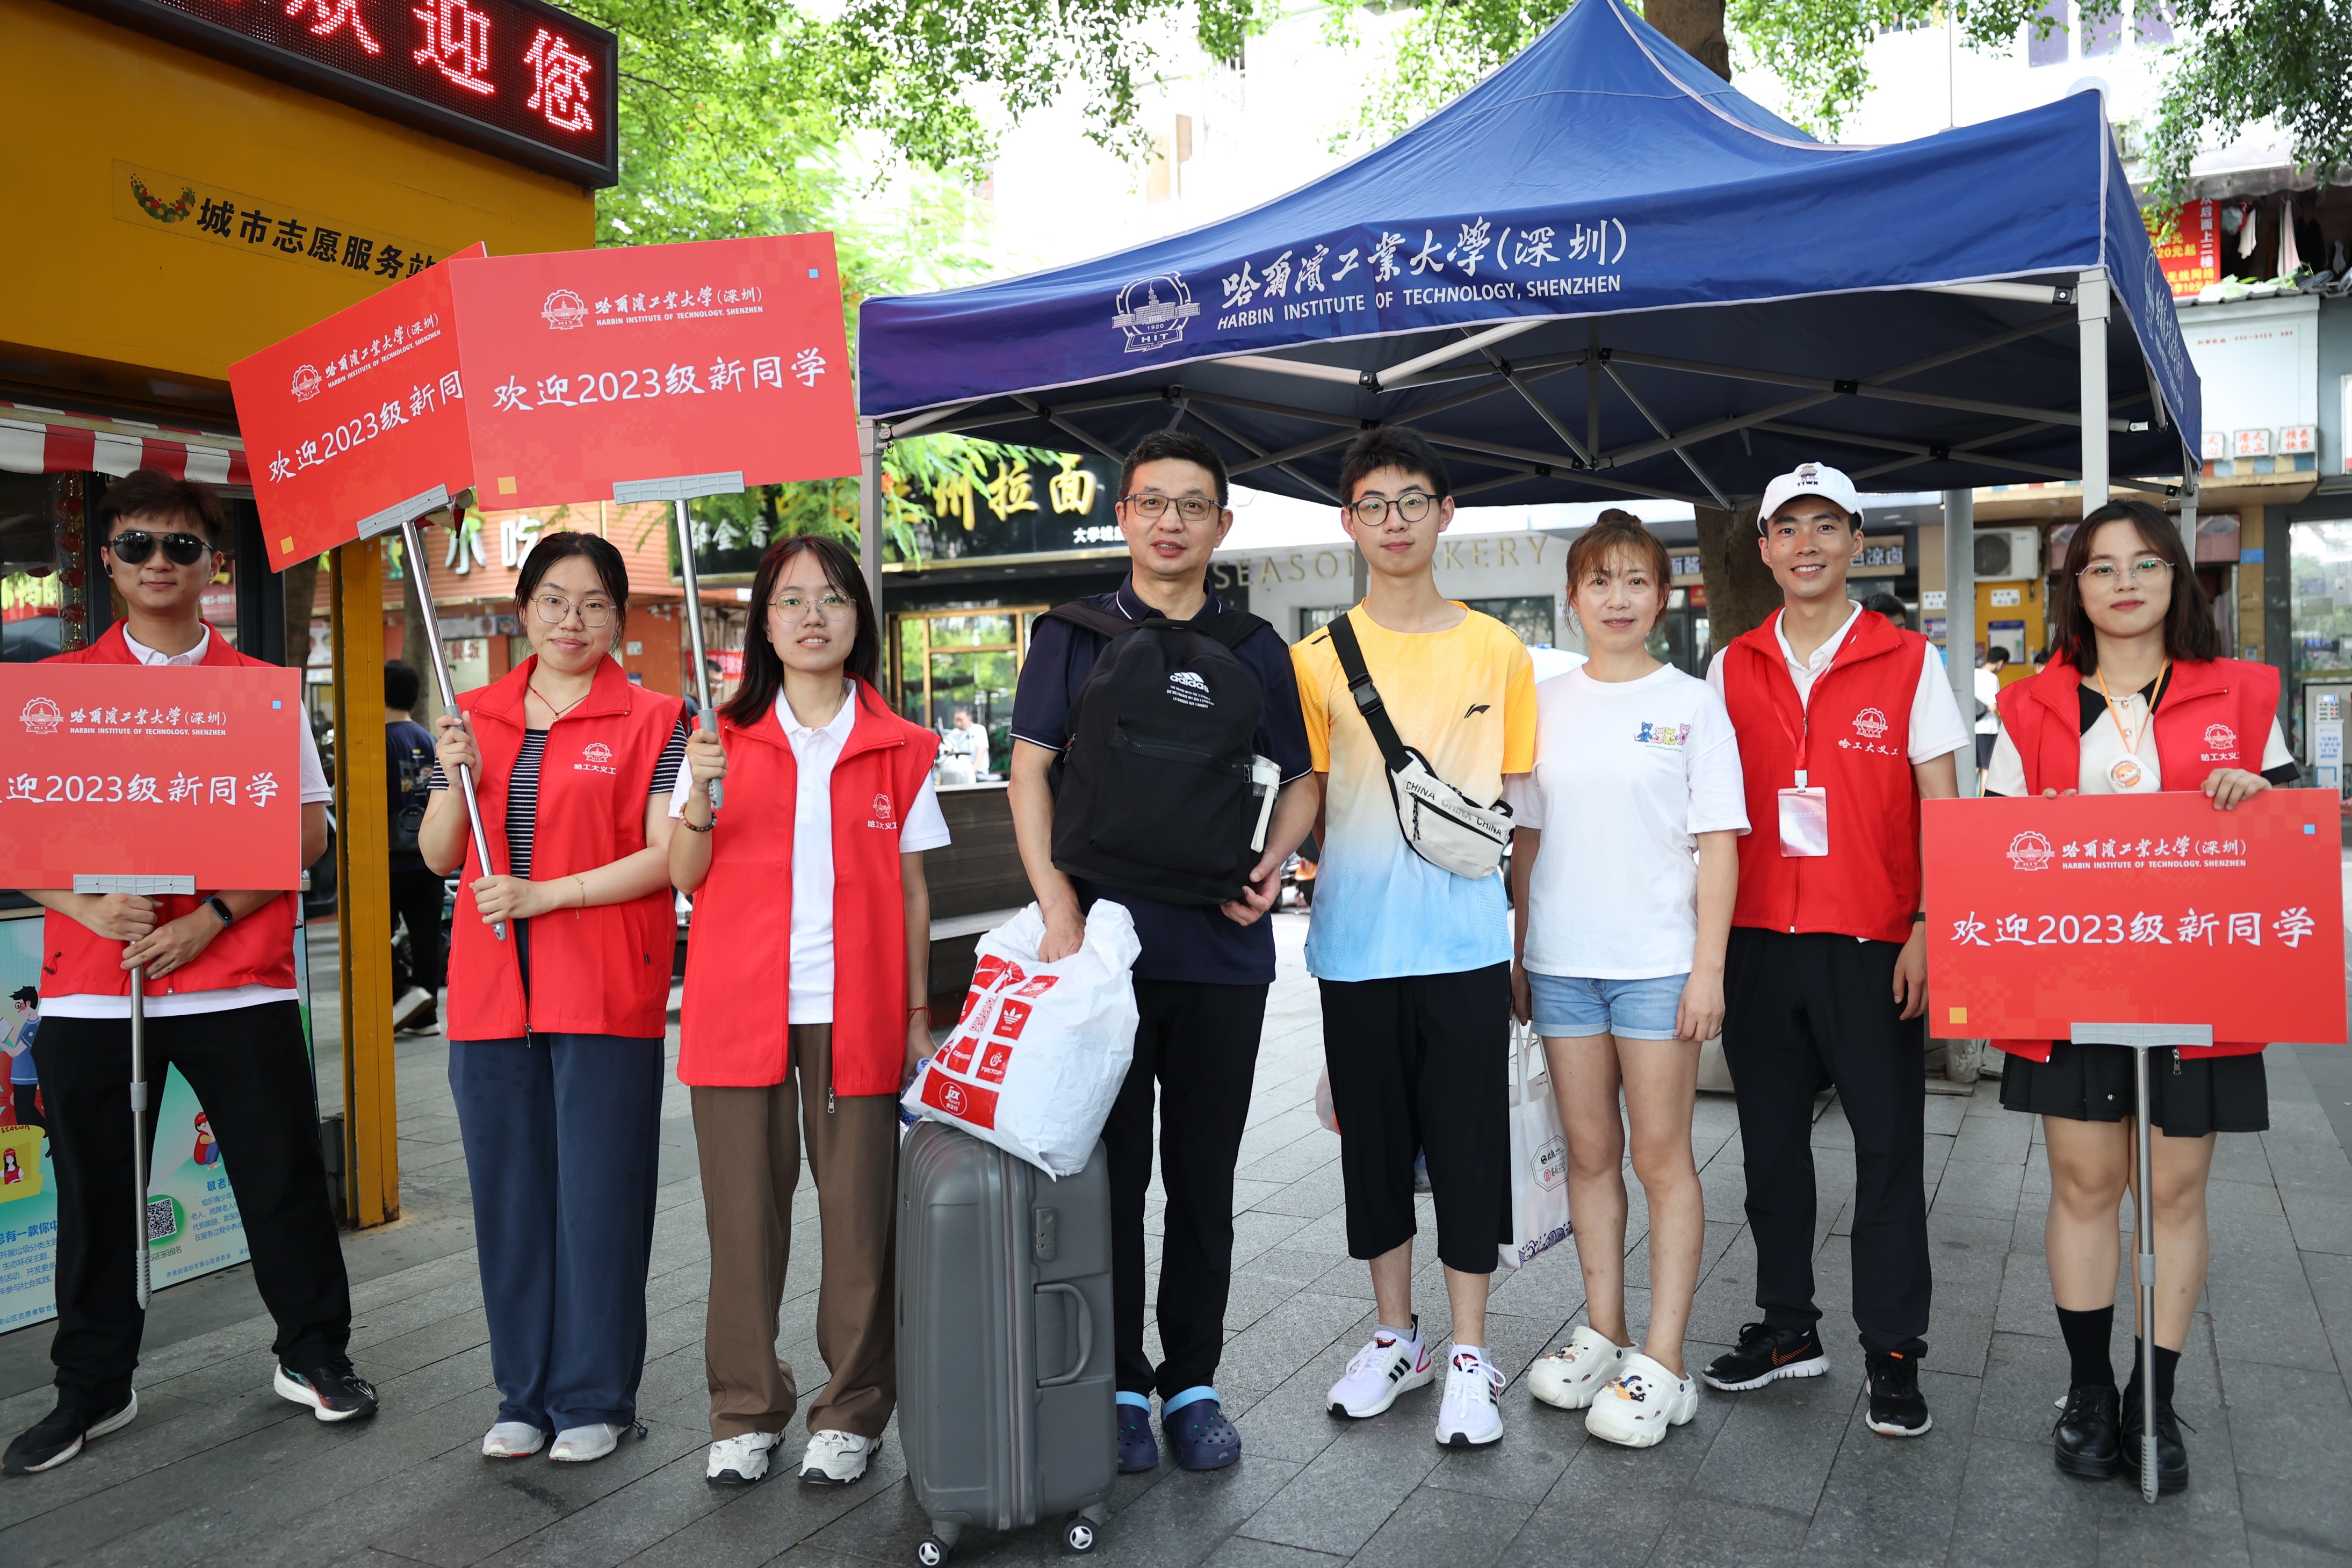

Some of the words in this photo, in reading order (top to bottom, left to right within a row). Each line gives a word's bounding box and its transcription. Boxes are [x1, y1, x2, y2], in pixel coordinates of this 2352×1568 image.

[1217, 308, 1274, 330] HARBIN
[1283, 294, 1366, 321] INSTITUTE
[1375, 291, 1394, 309] OF
[1403, 282, 1521, 306] TECHNOLOGY,
[1526, 274, 1621, 297] SHENZHEN
[596, 317, 624, 326] HARBIN
[626, 314, 661, 324] INSTITUTE
[727, 306, 763, 315] SHENZHEN
[1141, 333, 1169, 343] HIT
[328, 375, 346, 388] HARBIN
[347, 363, 372, 379] INSTITUTE
[372, 358, 379, 366] OF
[415, 329, 441, 346] SHENZHEN
[492, 347, 826, 412] 欢迎2023级新同学
[1433, 536, 1548, 573] KERY
[1170, 674, 1209, 693] adidas
[1838, 738, 1898, 755] 哈工大义工
[574, 763, 616, 775] 哈工大义工
[0, 771, 279, 807] 迎2023级新同学
[1406, 781, 1435, 800] CHINA
[1477, 817, 1502, 837] CHINA
[868, 820, 897, 829] 哈工大义工
[2062, 862, 2090, 870] HARBIN
[2094, 861, 2132, 869] INSTITUTE
[2204, 859, 2246, 868] SHENZHEN
[1950, 907, 2315, 948] 欢迎2023级新同学
[201, 1191, 236, 1206] 组织青少年
[2, 1249, 57, 1271] 生态环保主题、
[149, 1246, 182, 1261] 迎扫码报名
